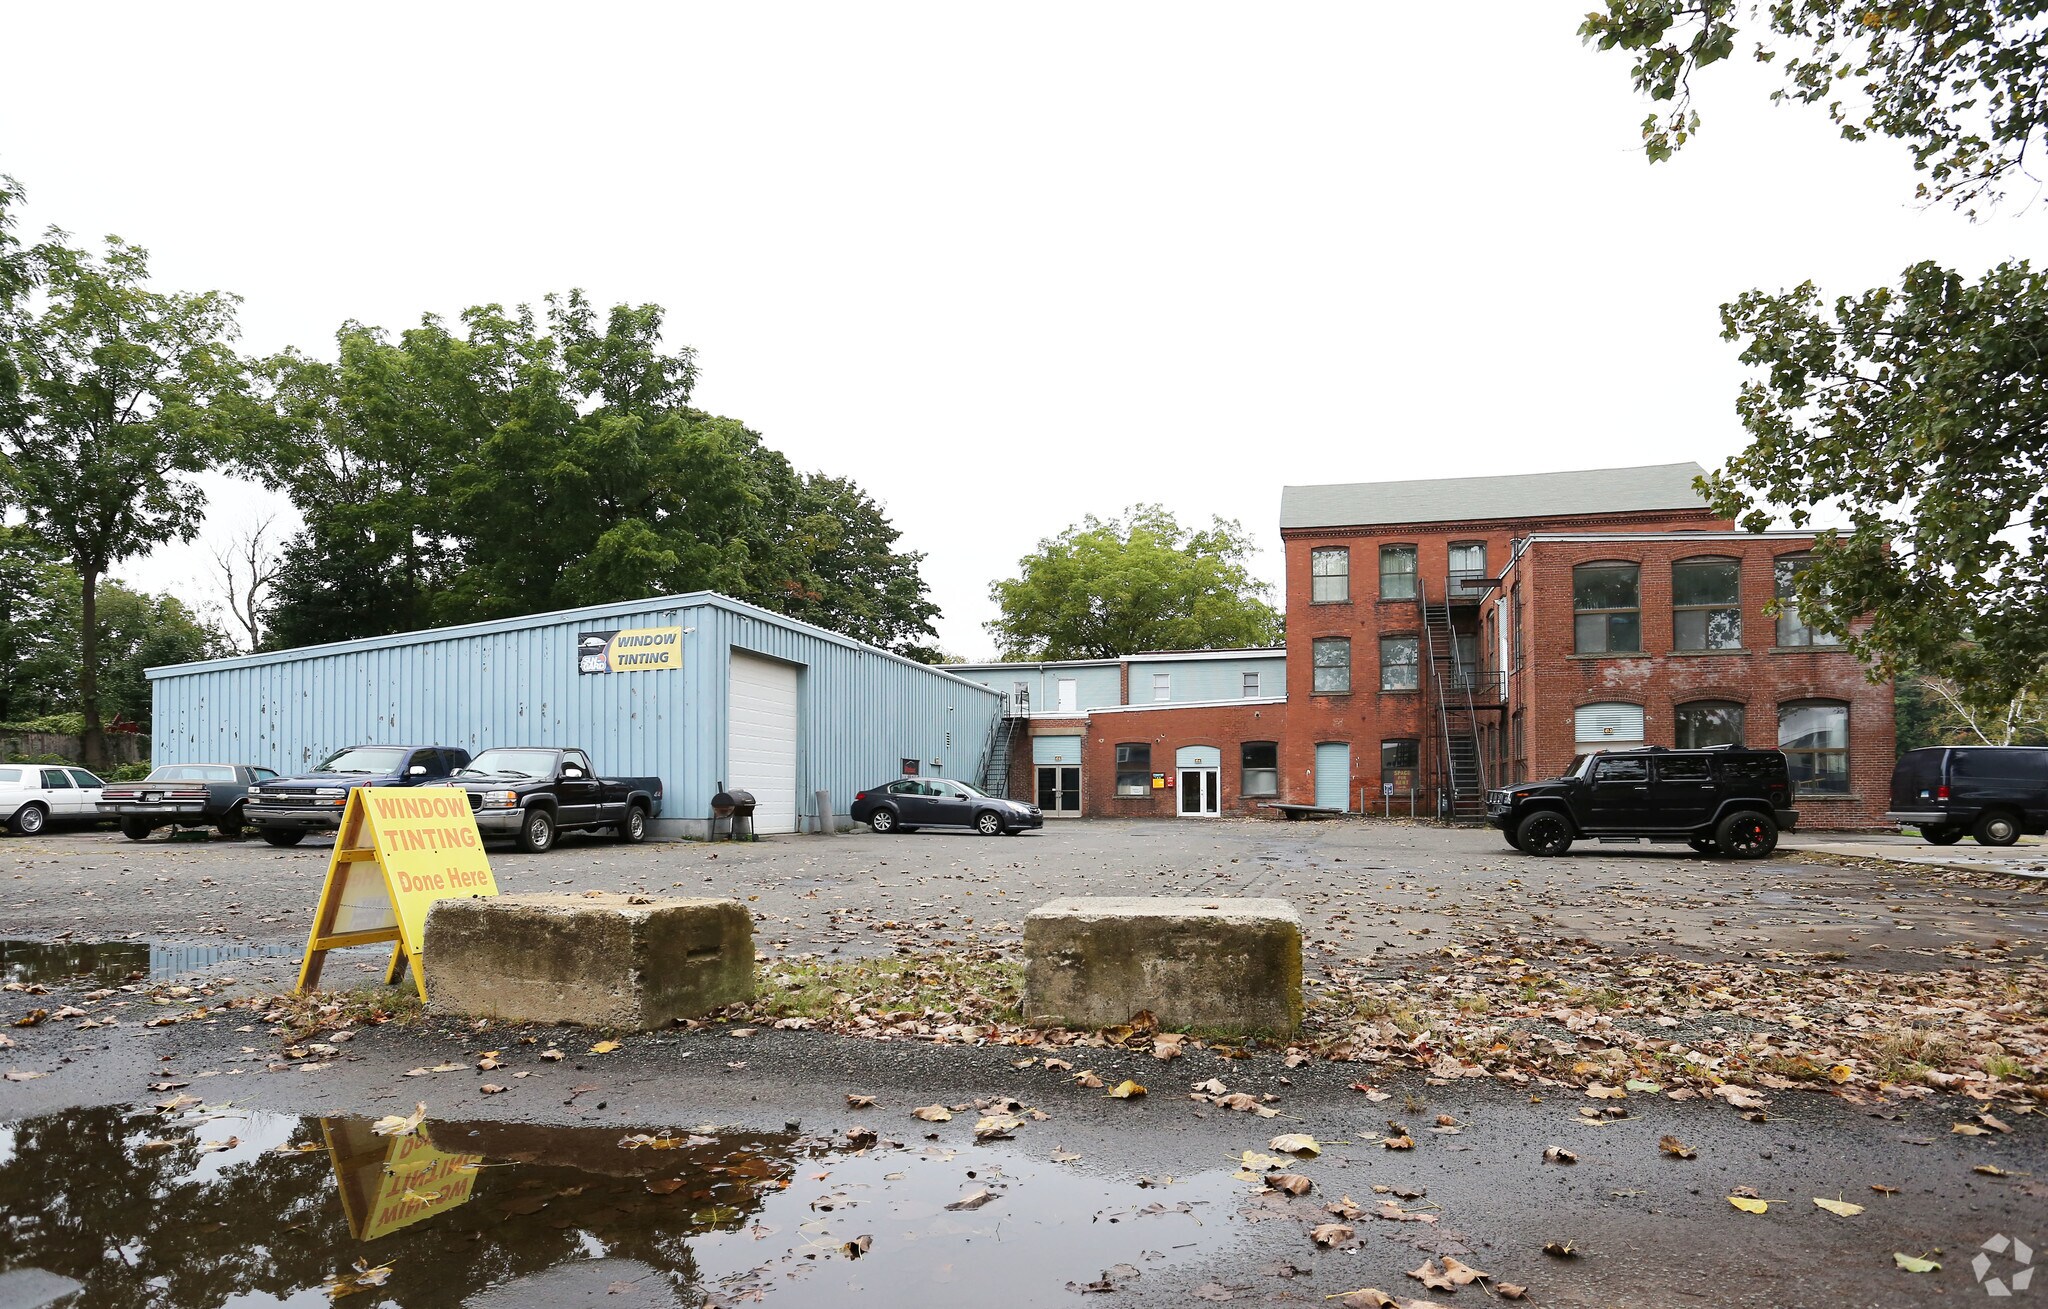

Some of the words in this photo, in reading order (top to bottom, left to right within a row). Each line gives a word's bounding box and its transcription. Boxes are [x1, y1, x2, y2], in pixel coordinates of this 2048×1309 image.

[618, 633, 677, 648] WINDOW
[618, 651, 669, 666] TINTING
[374, 797, 466, 820] WINDOW
[383, 827, 477, 852] TINTING
[398, 871, 445, 892] Done
[446, 867, 488, 889] Here
